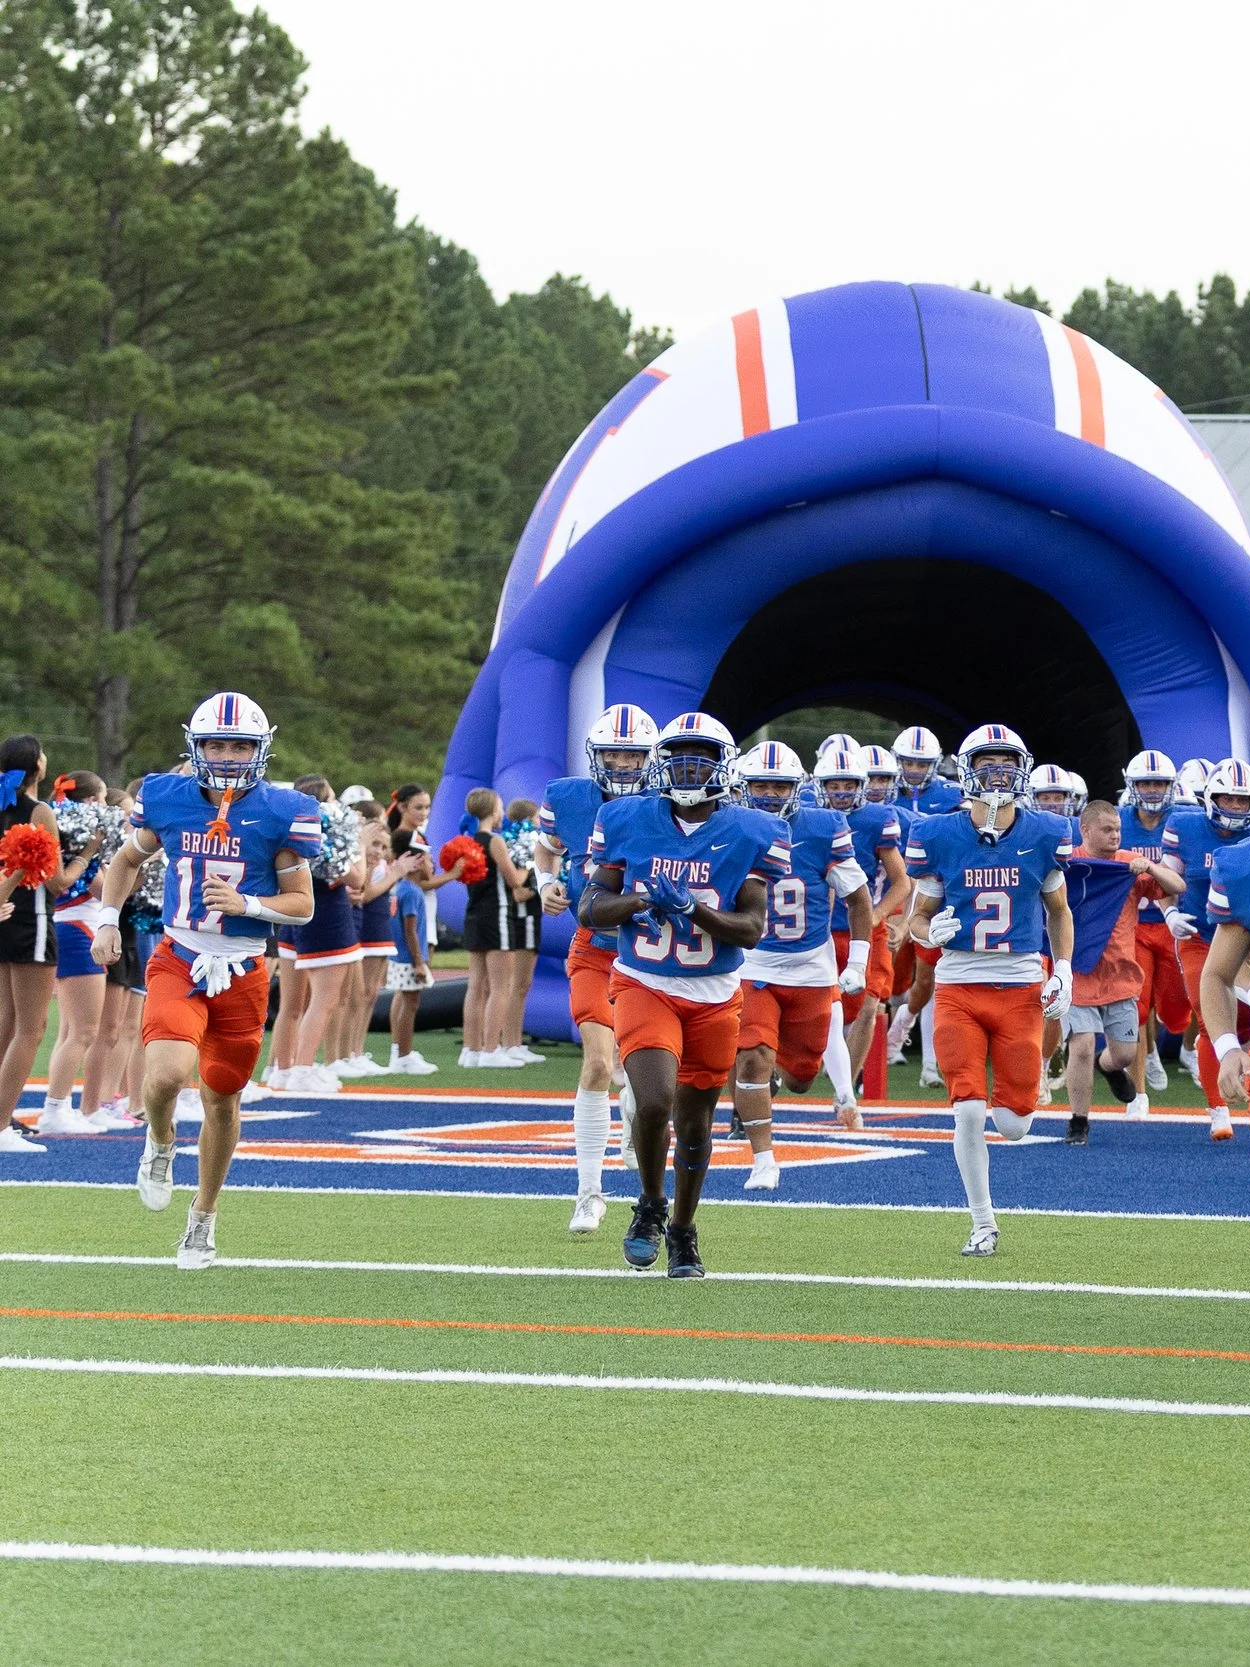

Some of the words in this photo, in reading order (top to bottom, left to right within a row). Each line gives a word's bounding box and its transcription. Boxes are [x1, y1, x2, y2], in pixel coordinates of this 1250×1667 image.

[172, 856, 246, 934] 17
[764, 877, 807, 940] 9
[964, 867, 1020, 888] BRUINS
[973, 889, 1012, 953] 2
